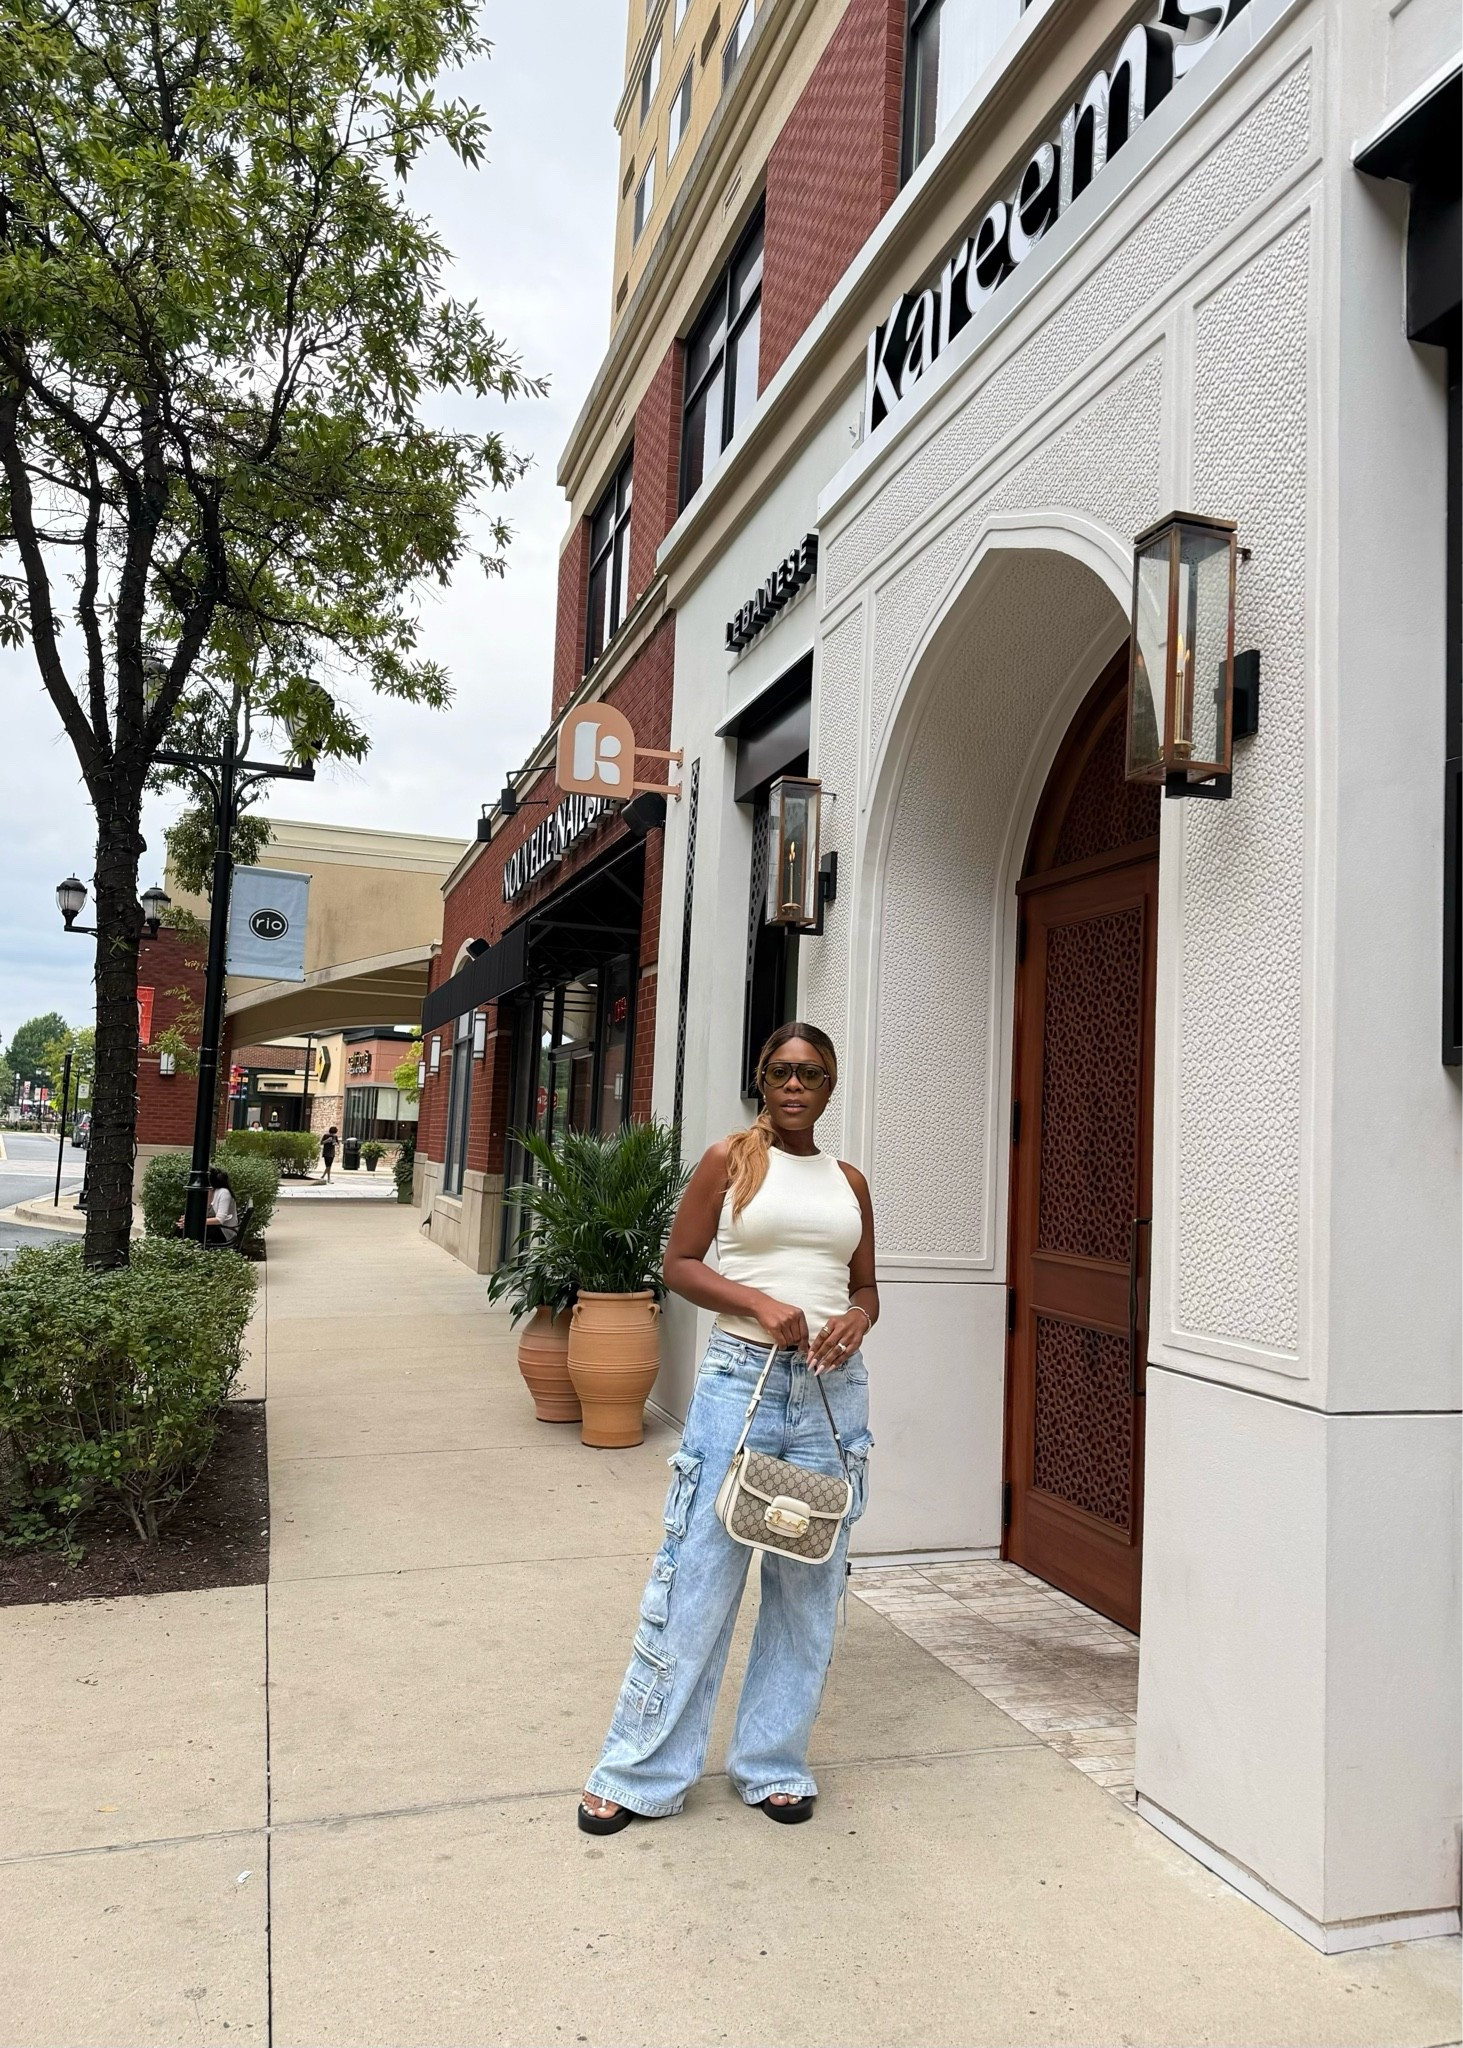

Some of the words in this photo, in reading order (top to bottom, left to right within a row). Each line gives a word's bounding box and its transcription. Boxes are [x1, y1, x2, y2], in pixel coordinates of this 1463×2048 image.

[725, 533, 818, 652] LEBANESE
[503, 812, 556, 903] NOUVELLE
[256, 917, 283, 931] rio
